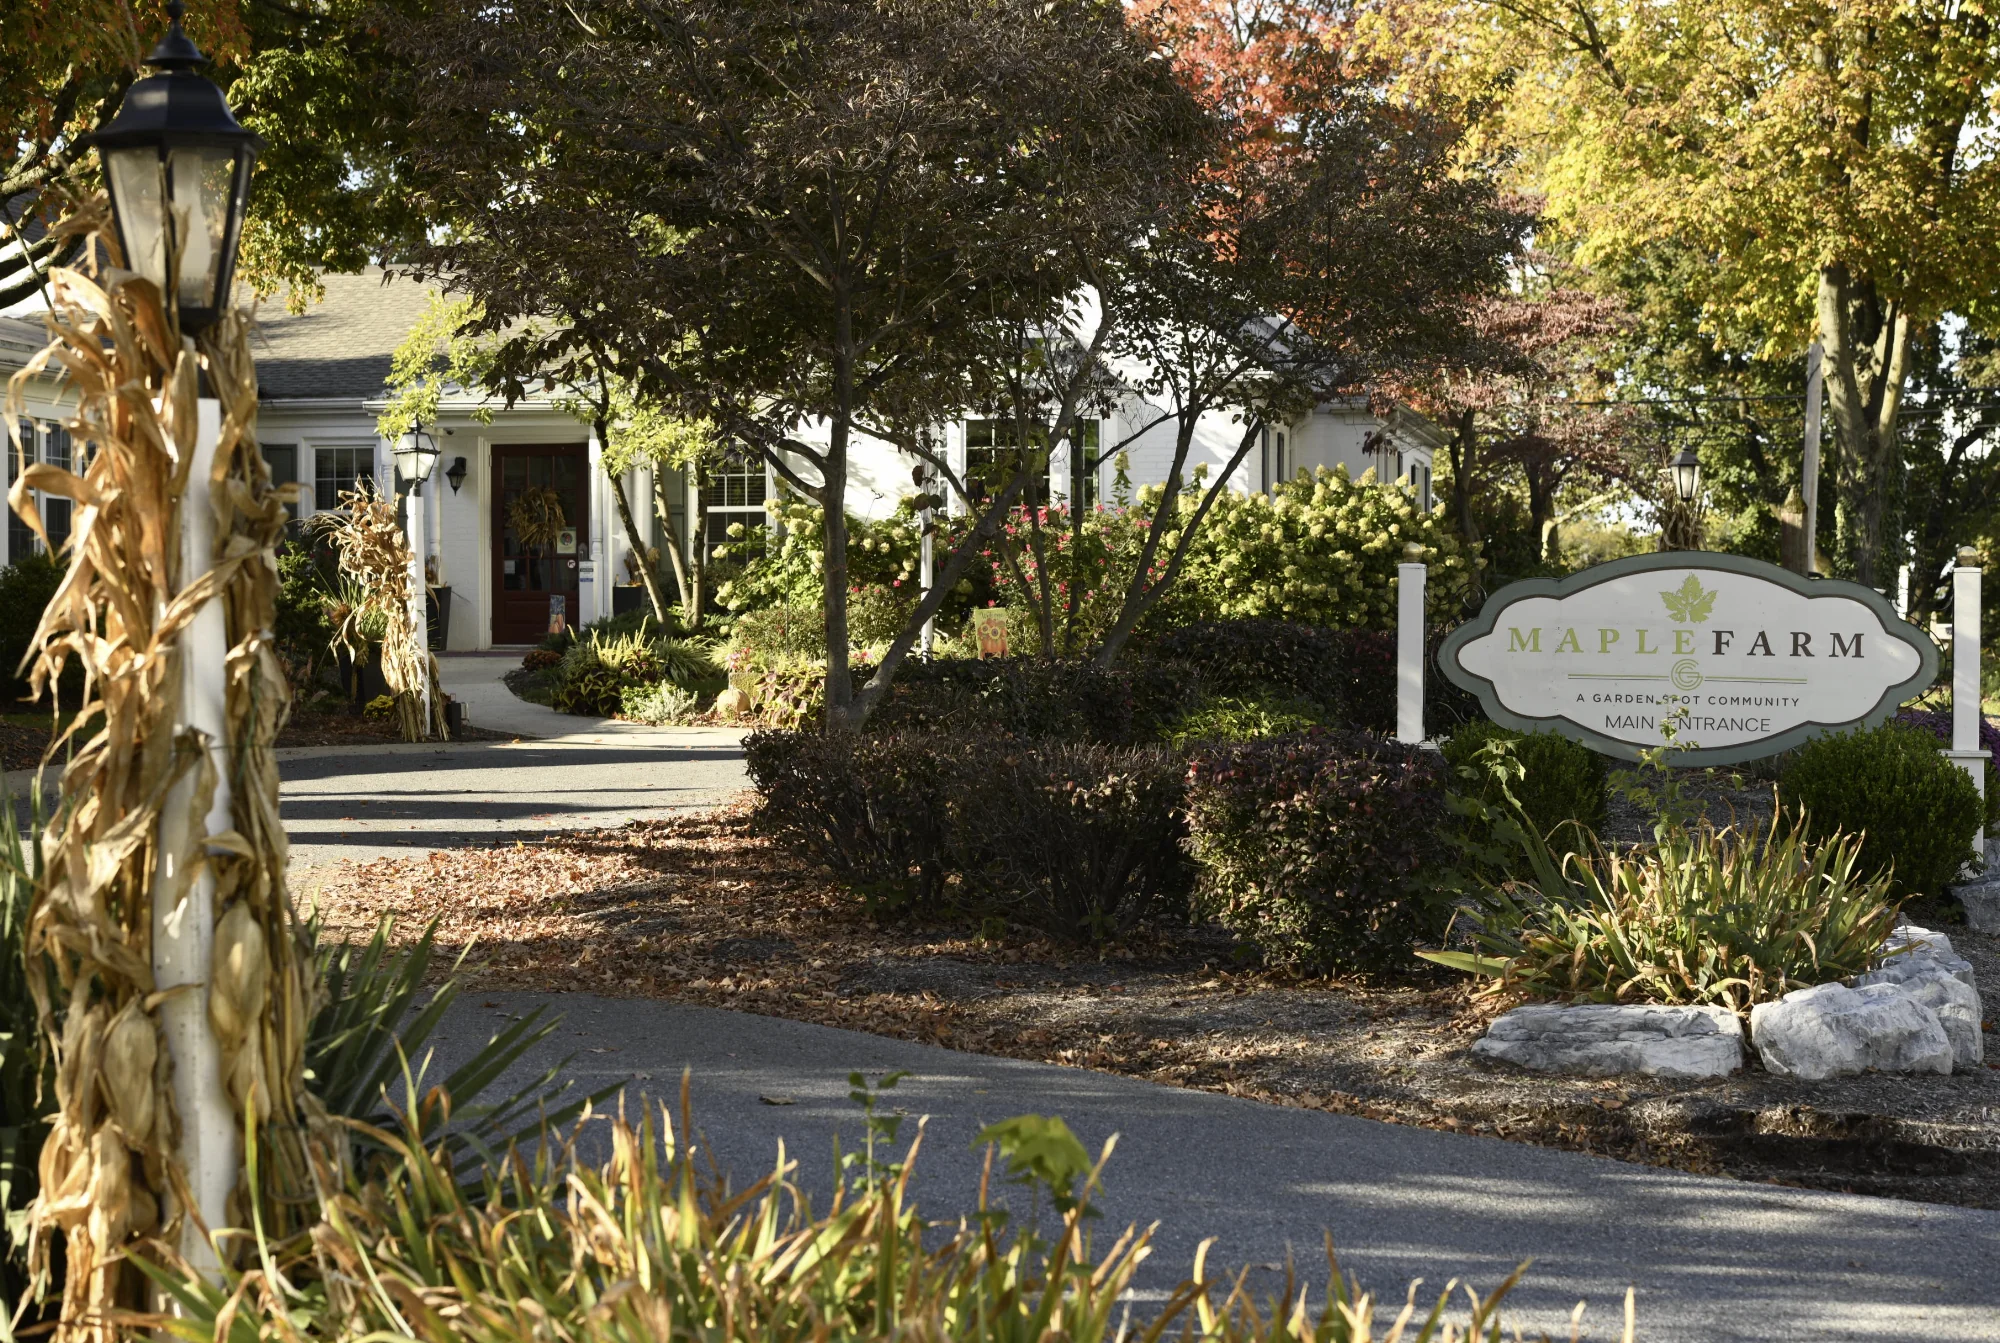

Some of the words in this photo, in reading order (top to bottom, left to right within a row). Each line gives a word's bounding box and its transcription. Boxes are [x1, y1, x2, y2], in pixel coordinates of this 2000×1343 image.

[1507, 627, 1696, 655] MAPLE
[1711, 630, 1865, 658] FARM
[1576, 693, 1585, 703] A
[1592, 693, 1655, 704] GARDEN
[1707, 695, 1800, 707] COMMUNITY
[1605, 715, 1655, 730] MAIN
